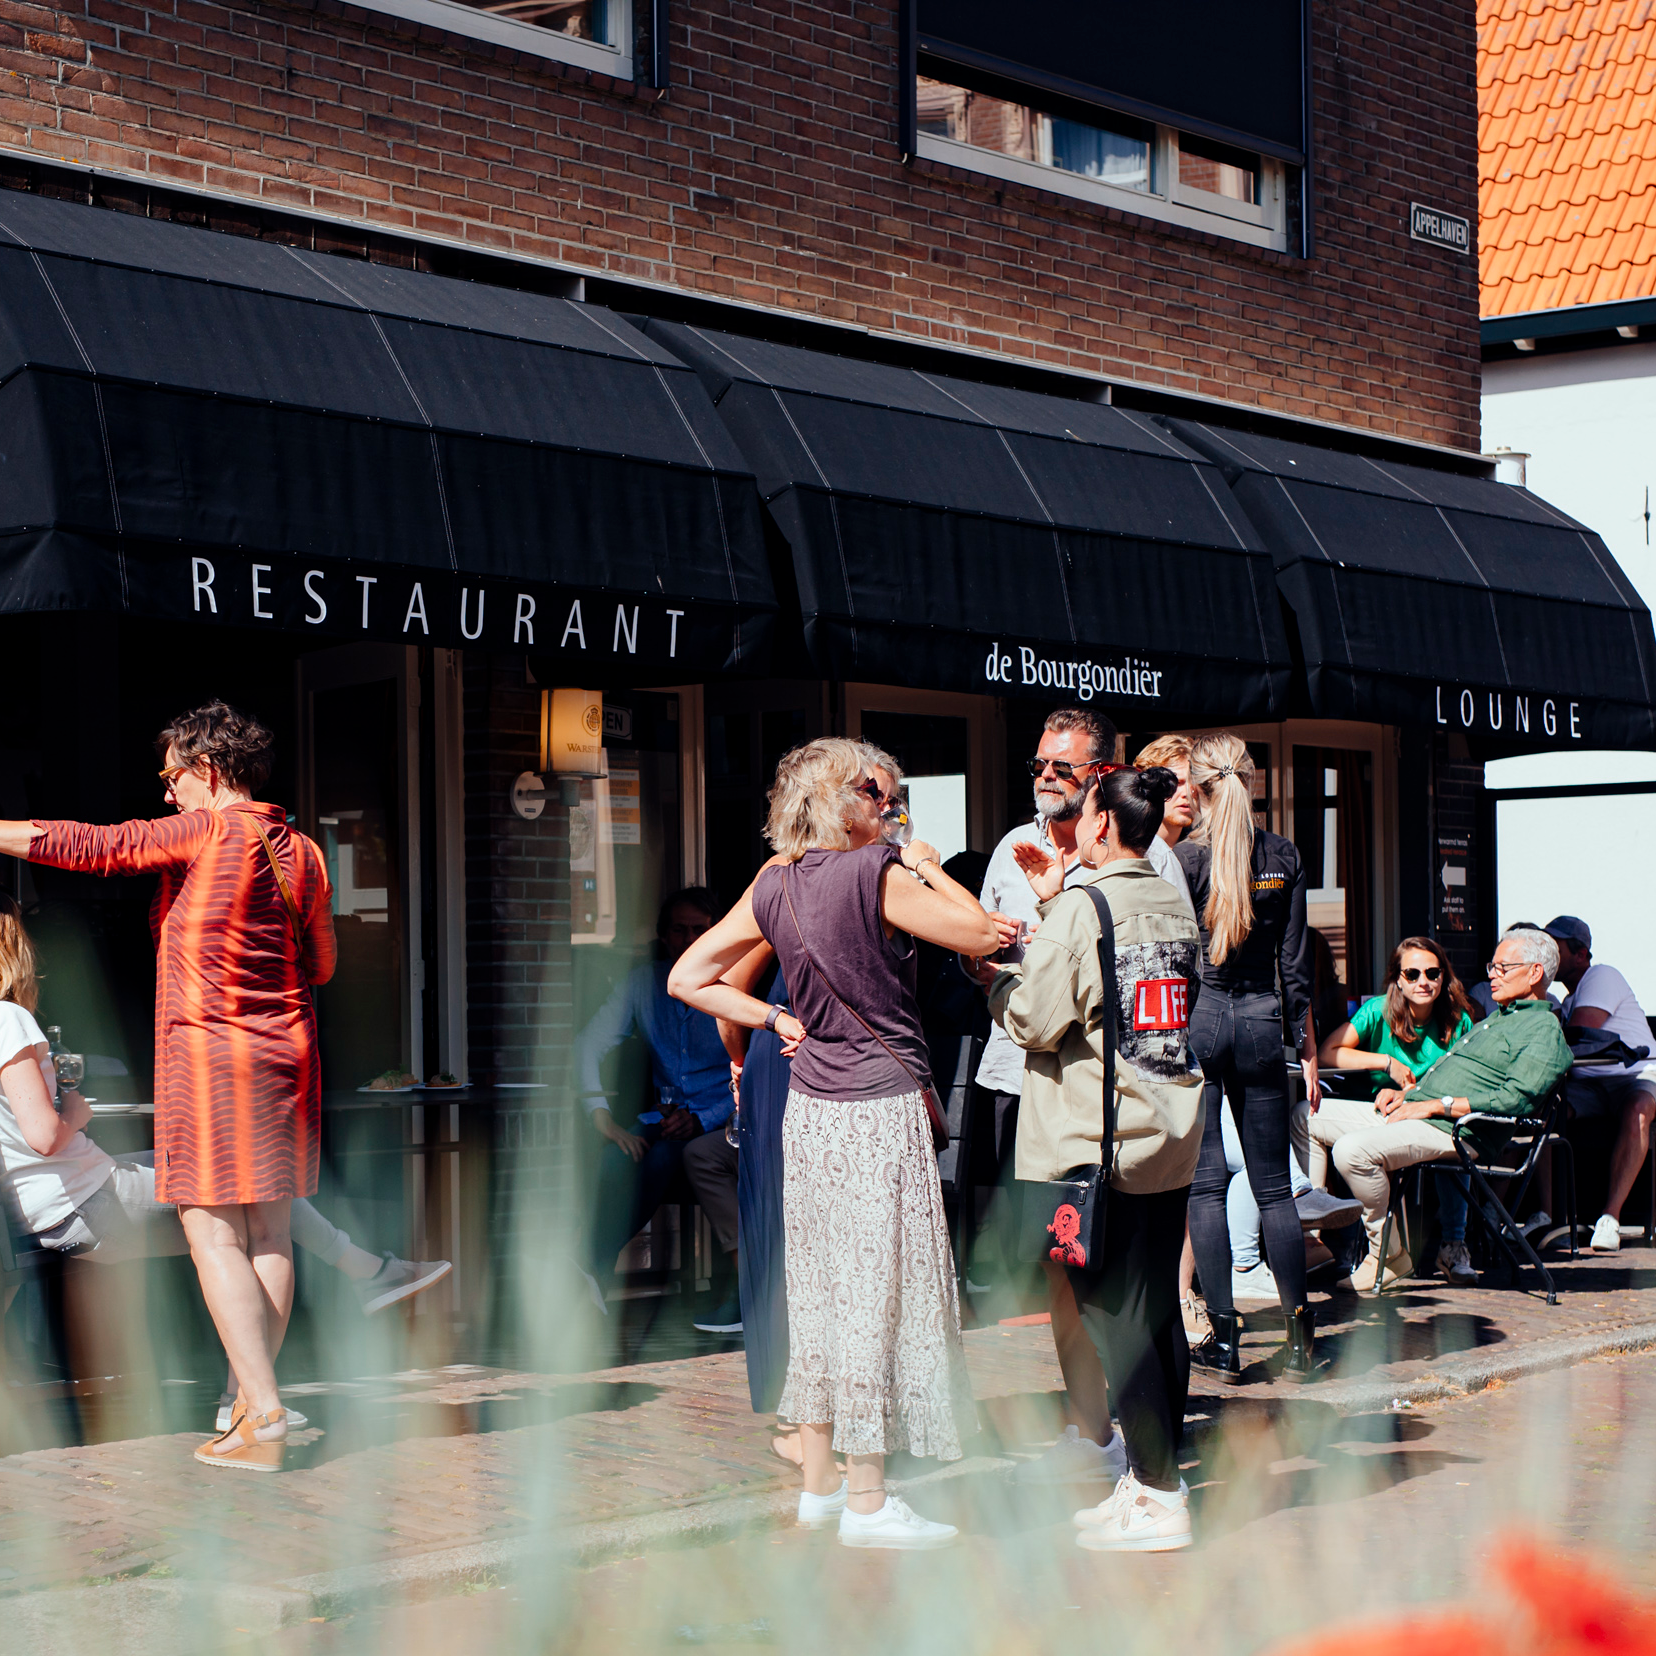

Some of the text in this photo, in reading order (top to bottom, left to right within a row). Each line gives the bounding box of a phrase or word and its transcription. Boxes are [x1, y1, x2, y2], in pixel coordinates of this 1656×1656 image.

[1415, 211, 1467, 245] APPELHAVEN
[191, 556, 685, 658] RESTAURANT
[985, 642, 1163, 701] de Bourgondiër
[1436, 686, 1582, 739] LOUNGE
[1138, 984, 1187, 1025] LIFE
